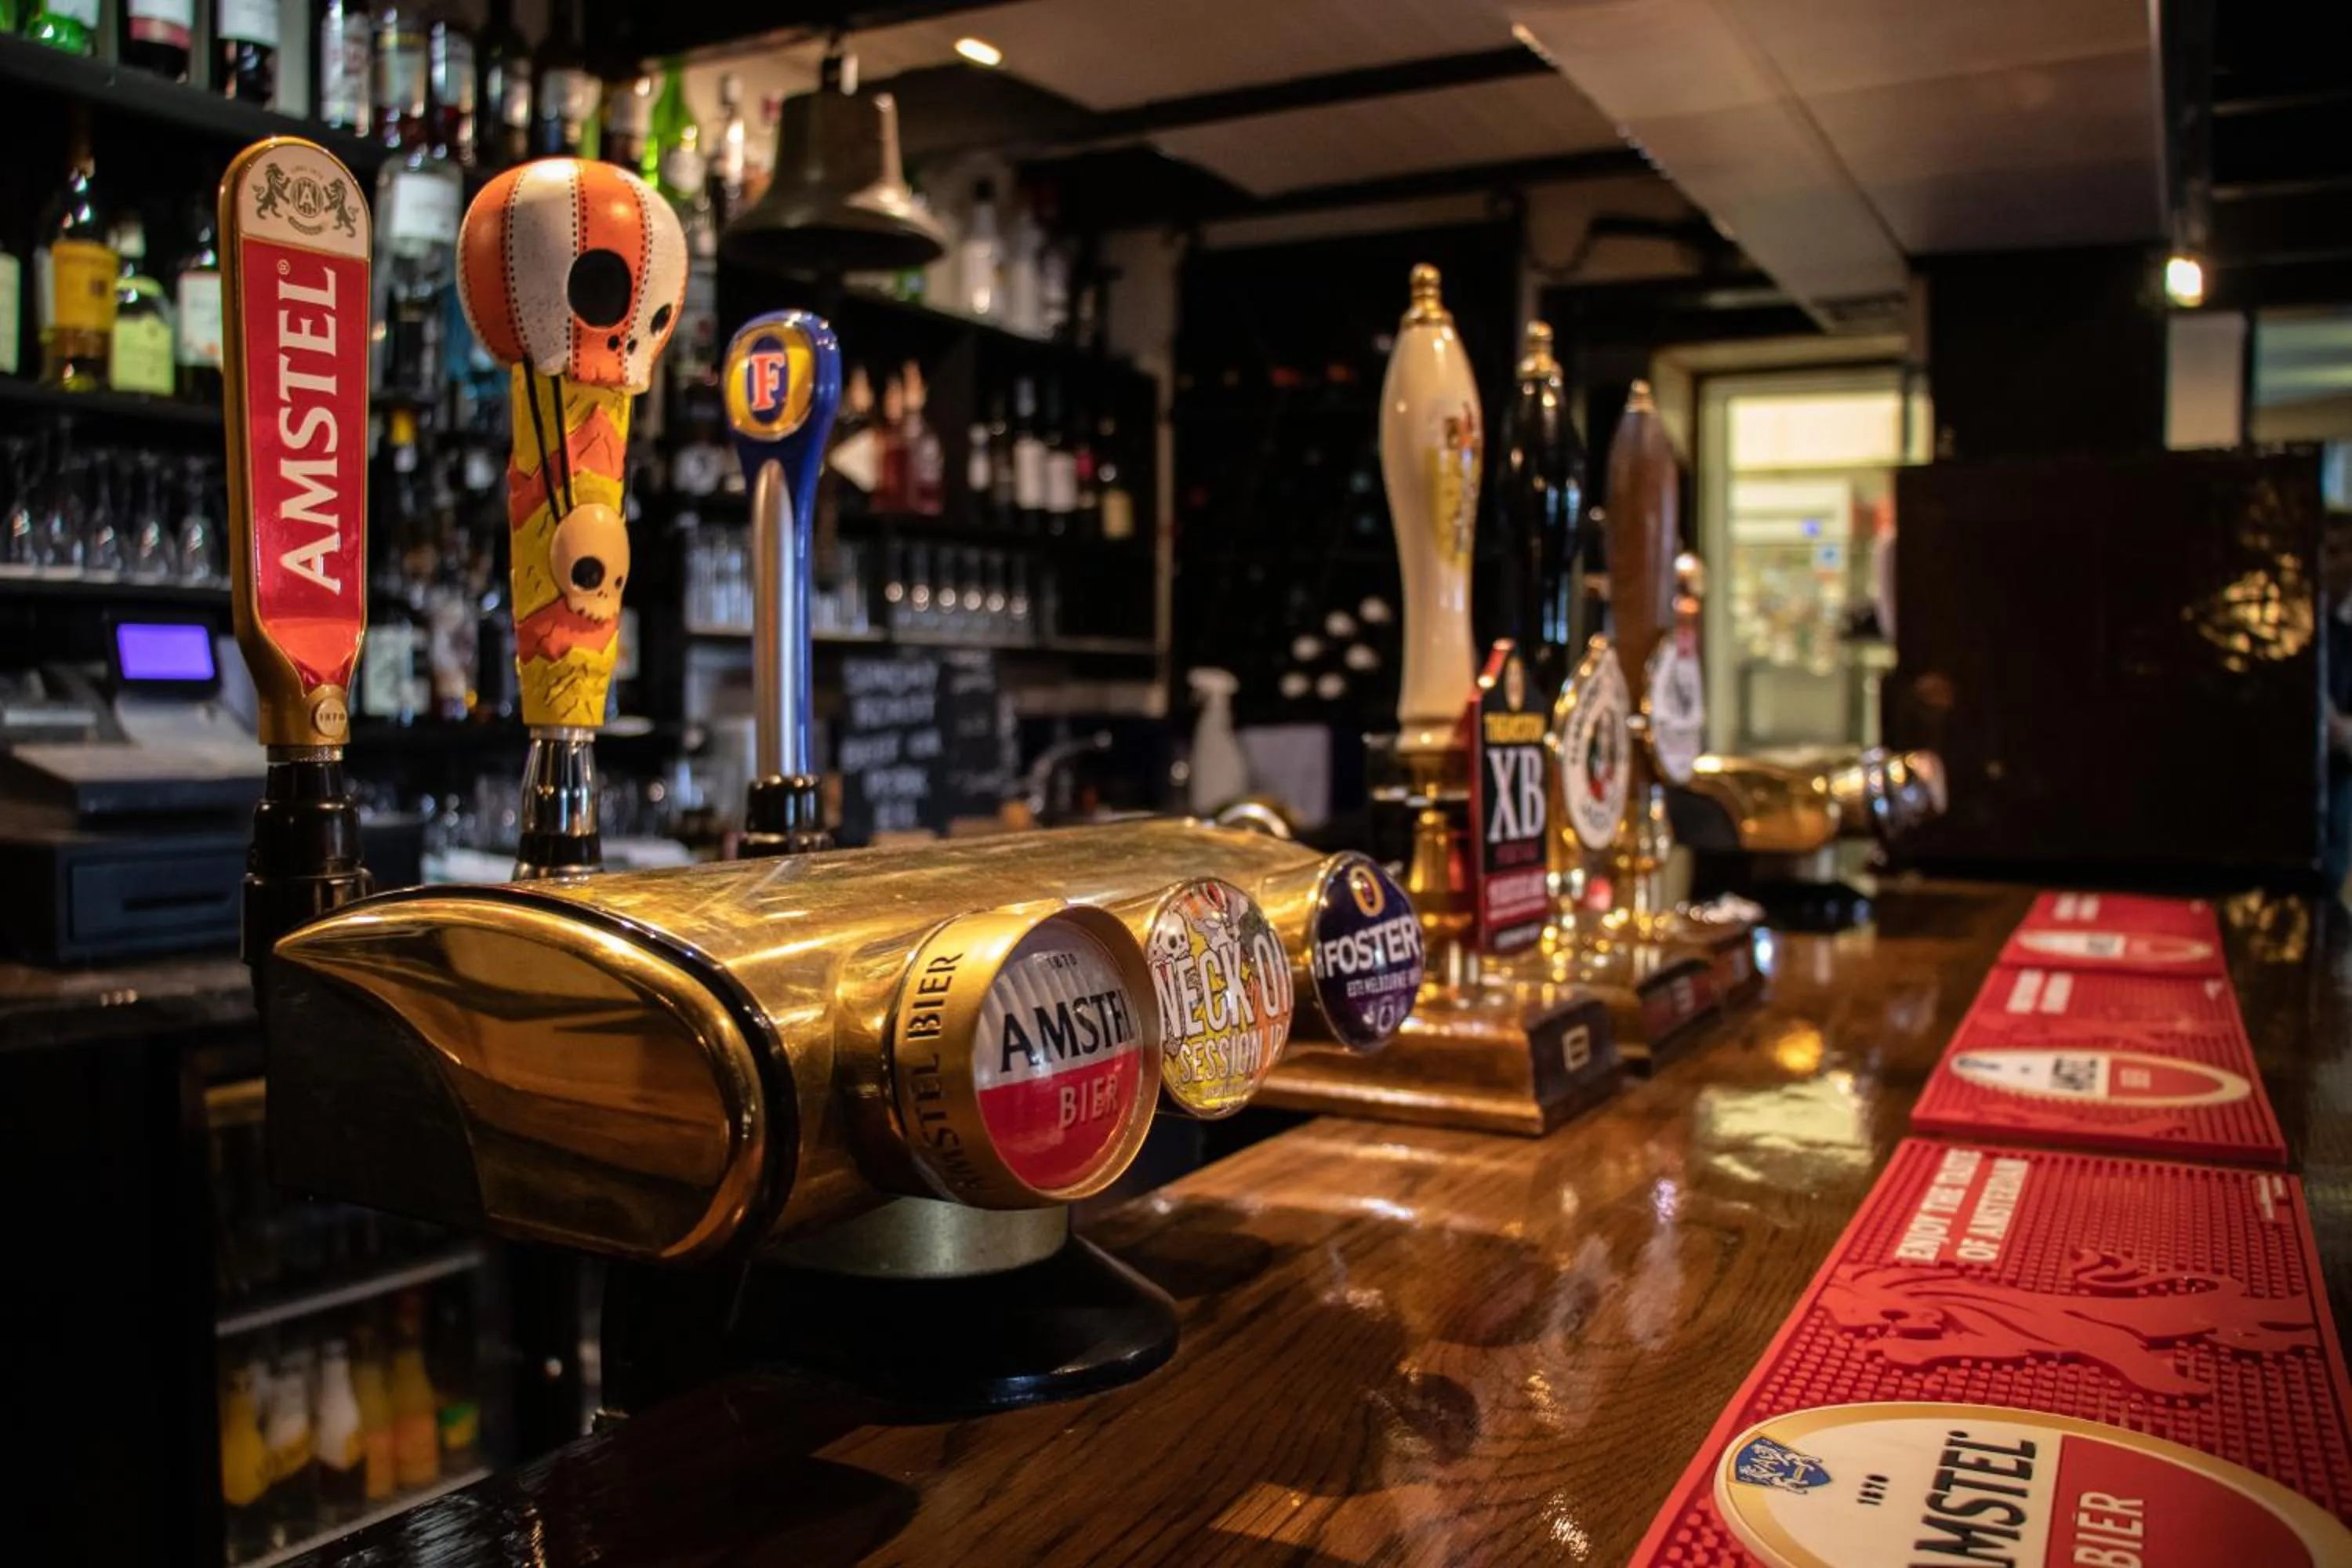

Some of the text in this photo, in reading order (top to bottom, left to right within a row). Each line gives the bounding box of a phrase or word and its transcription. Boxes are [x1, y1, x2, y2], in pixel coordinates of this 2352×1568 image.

[751, 352, 786, 411] F
[278, 266, 340, 594] AMSTEL
[1487, 746, 1546, 843] XB
[906, 952, 964, 1040] BIER
[1152, 939, 1255, 1042] NECK
[1179, 1029, 1265, 1083] SESSION
[1059, 1073, 1119, 1123] BIER
[1956, 1236, 2000, 1263] OF
[1907, 1439, 2037, 1568] MSTEL
[2073, 1491, 2144, 1568] BIER
